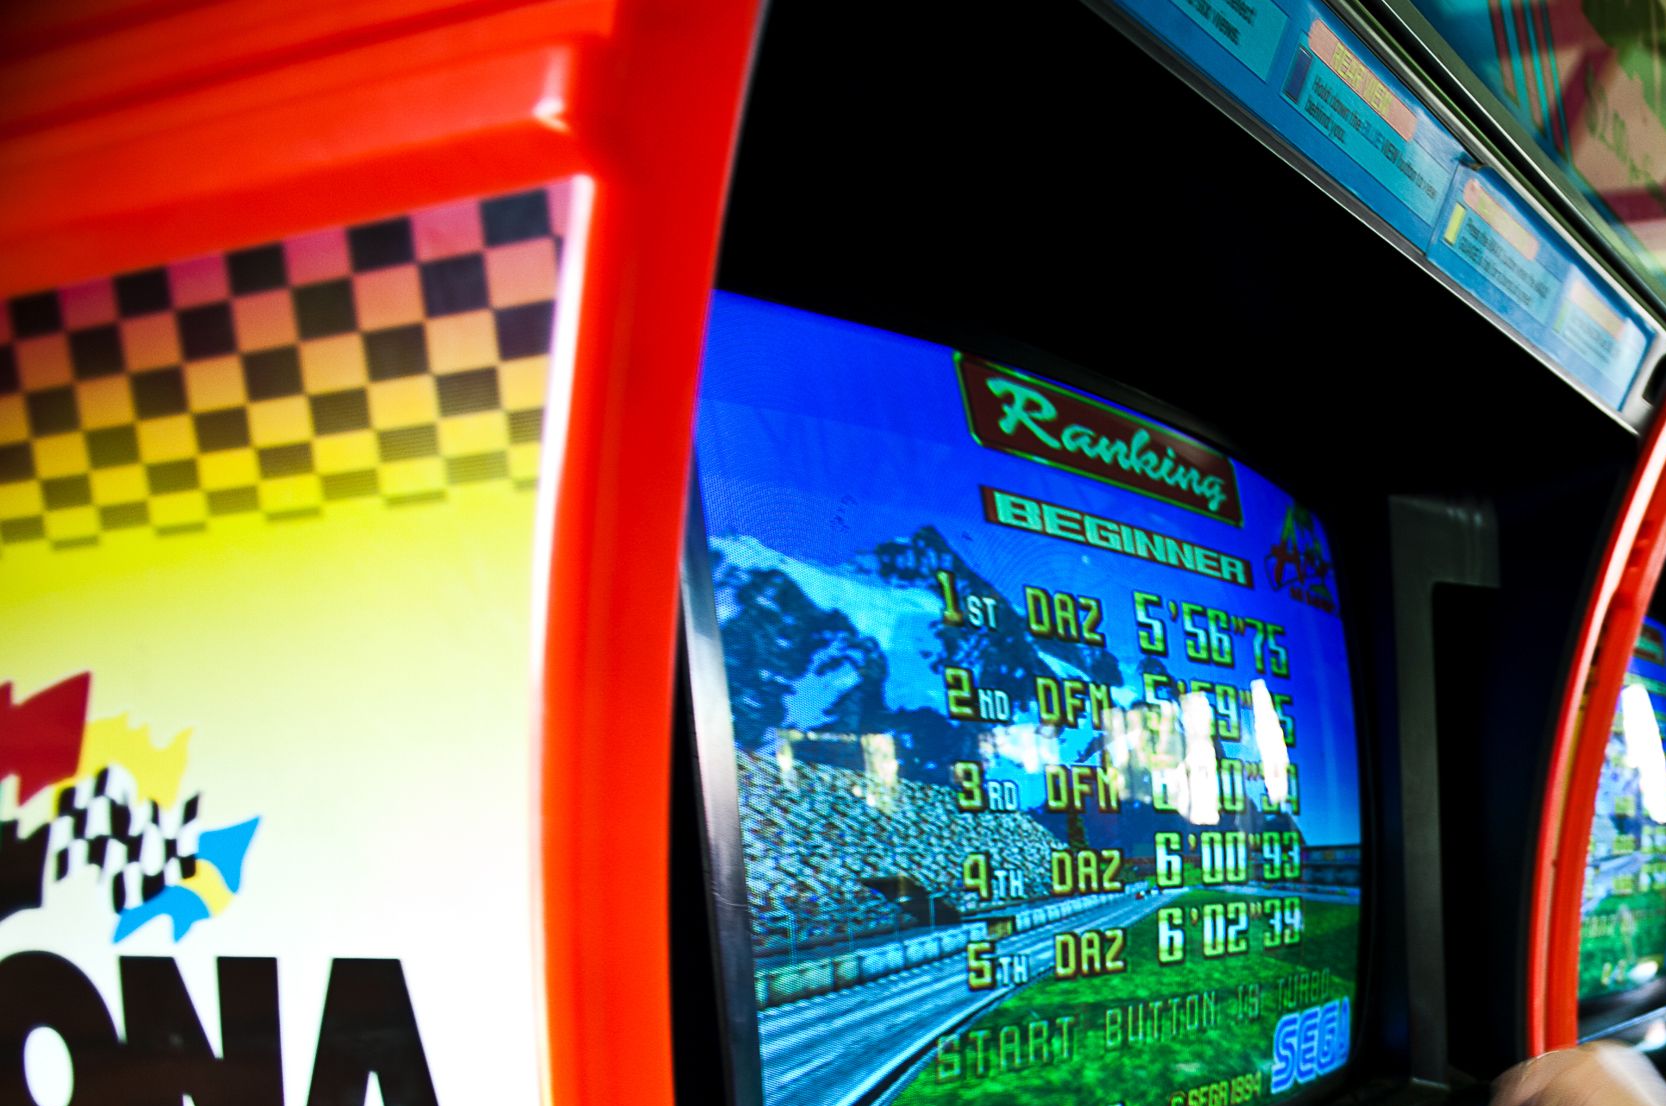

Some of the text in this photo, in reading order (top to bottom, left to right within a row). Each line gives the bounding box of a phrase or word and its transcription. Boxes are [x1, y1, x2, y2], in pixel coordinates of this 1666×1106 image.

[986, 377, 1226, 511] Ranking
[994, 490, 1248, 585] BEGINNER
[937, 570, 997, 630] 1ST
[1025, 585, 1105, 647] DAZ
[945, 666, 1010, 723] 2ND
[1036, 676, 1111, 729] DFM
[955, 761, 1019, 812] 3RD
[962, 852, 1025, 900] 4TH
[1051, 849, 1123, 895] DAZ
[967, 941, 1028, 990] 5TH
[1055, 929, 1127, 979] DAZ
[936, 1014, 1076, 1083] START
[1105, 990, 1218, 1048] BUTTON
[1236, 983, 1260, 1019] IS
